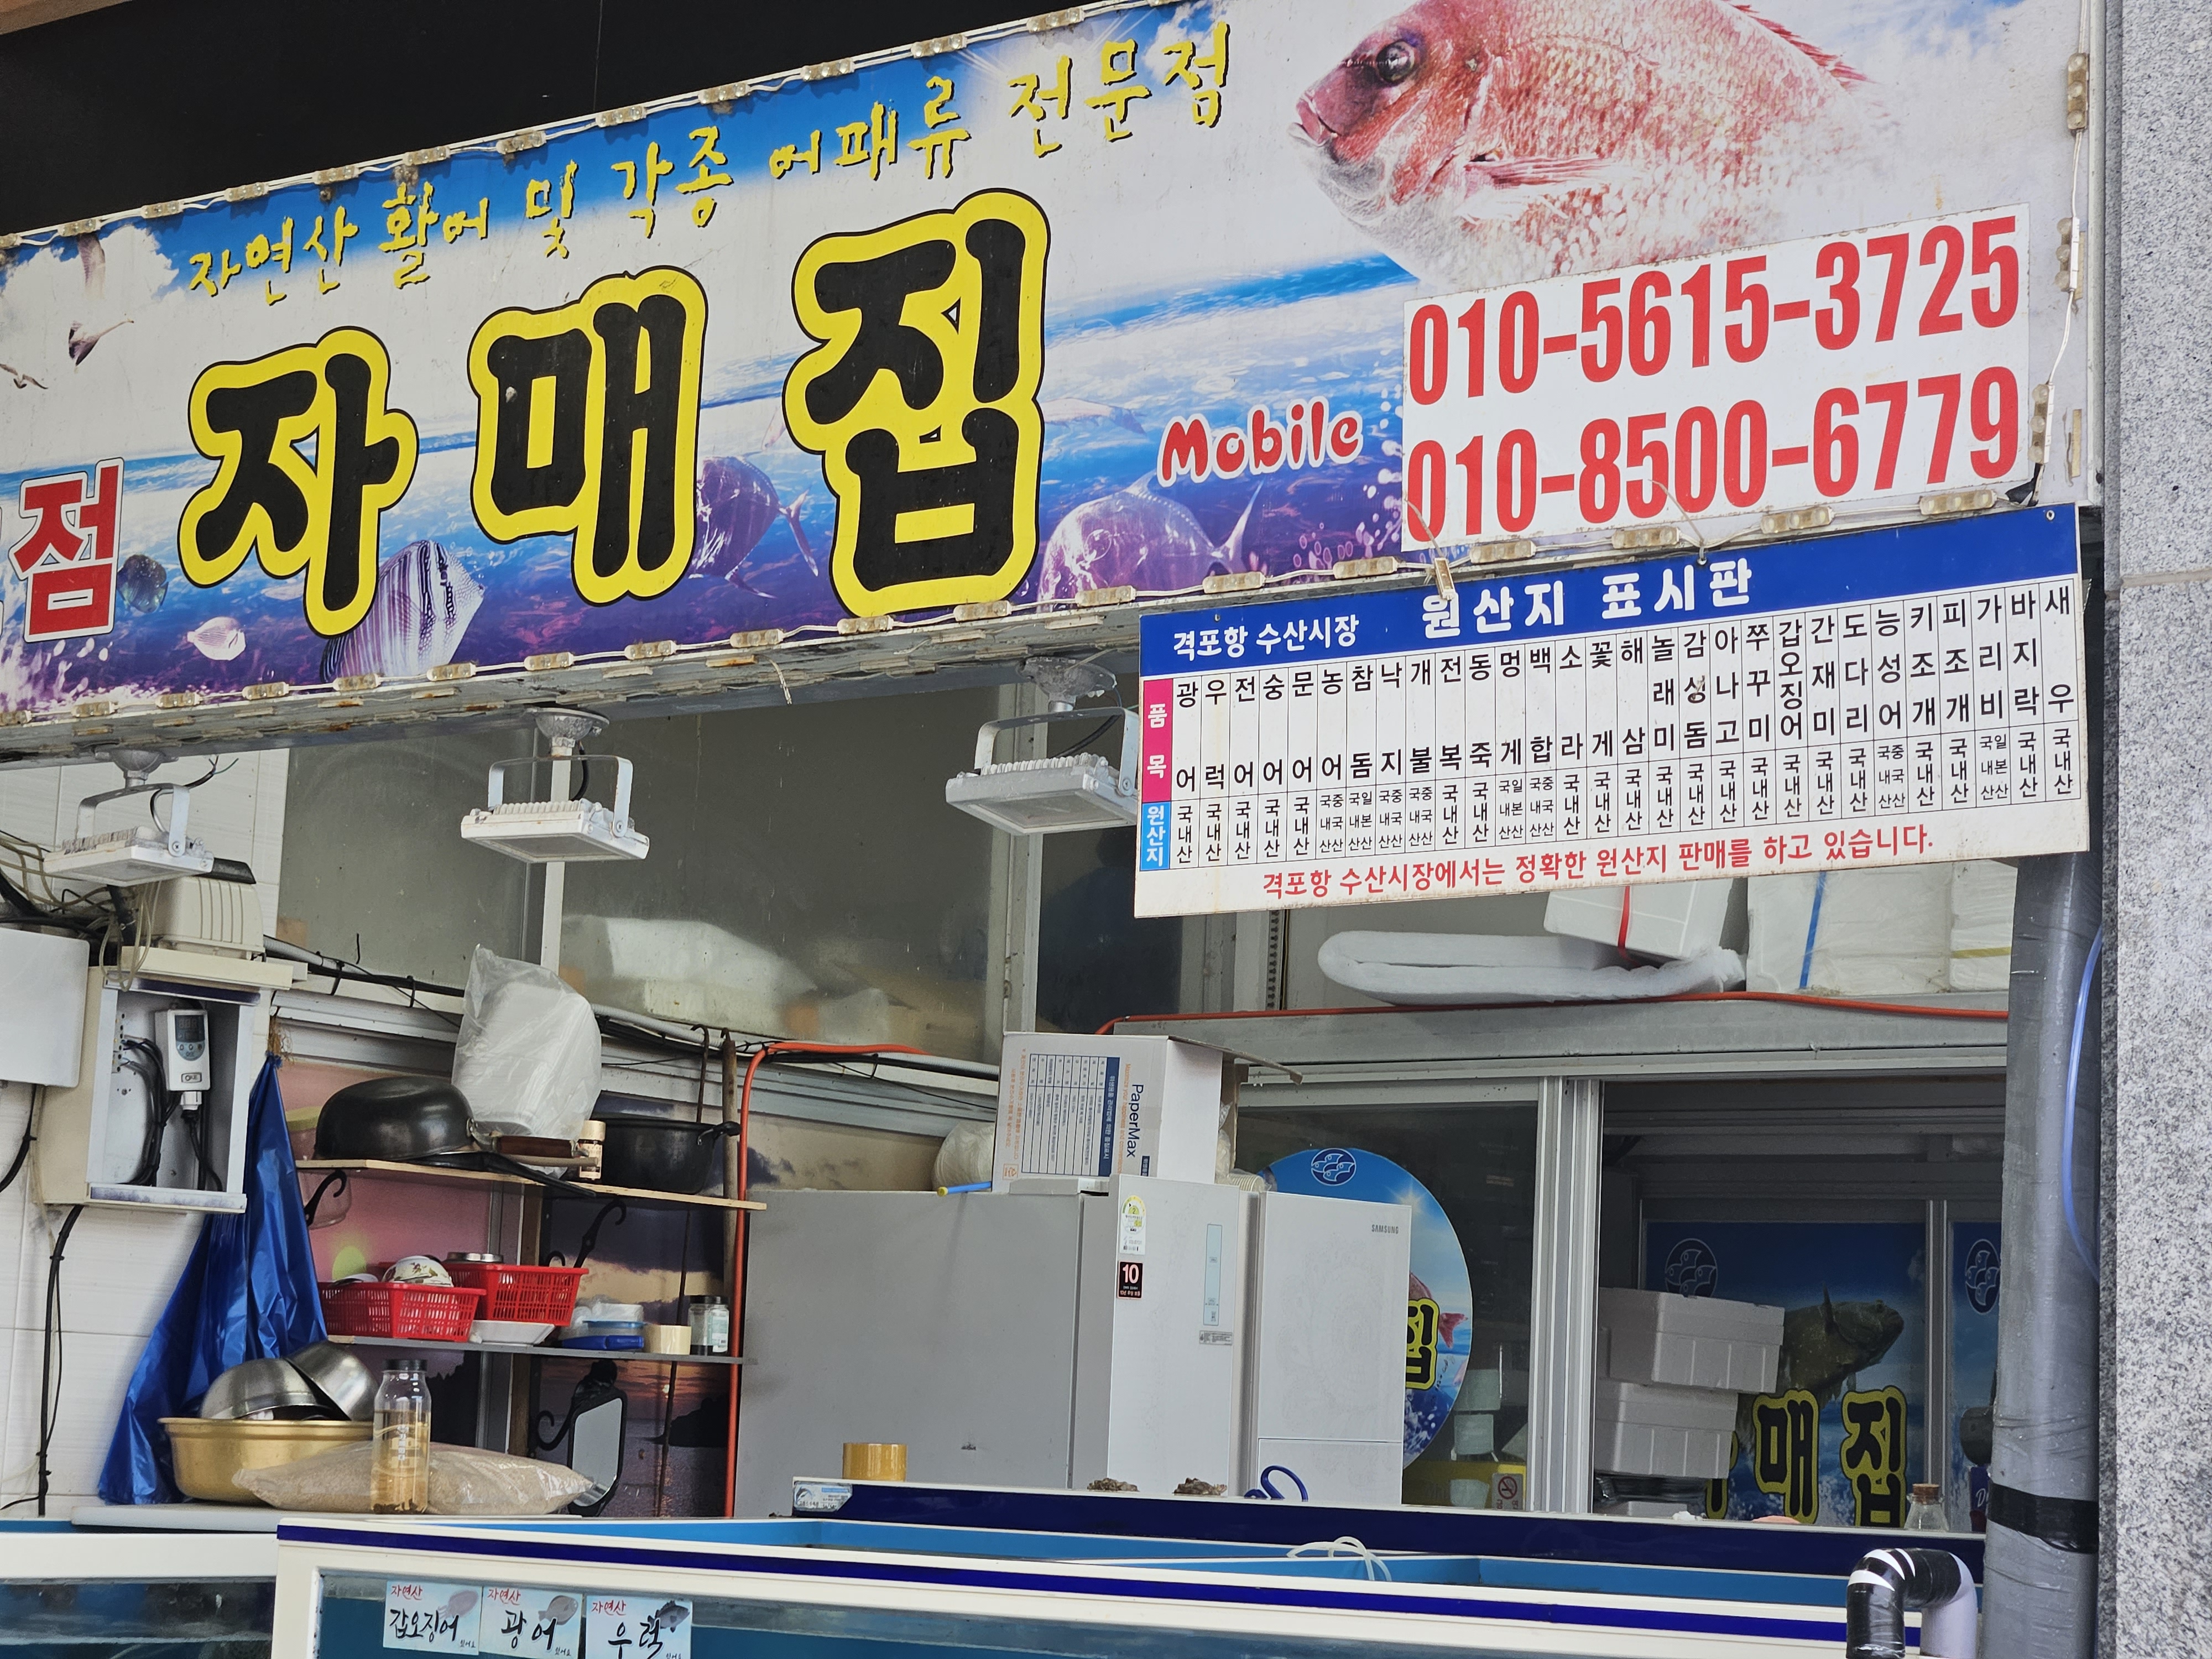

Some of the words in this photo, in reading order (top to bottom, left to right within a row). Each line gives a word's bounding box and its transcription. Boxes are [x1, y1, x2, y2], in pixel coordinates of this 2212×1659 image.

[189, 206, 358, 305] 자연산
[378, 182, 489, 288] 활어
[526, 161, 577, 258] 및
[612, 124, 733, 238] 각종
[769, 76, 970, 179] 어패류
[1008, 21, 1229, 155] 전문점
[1409, 215, 2020, 408] 010-5615-3725
[179, 191, 1049, 638] 자매집
[1159, 399, 1361, 482] Mobile
[1407, 366, 2020, 543] 010-8500-6779
[1422, 580, 1564, 640] 원산지
[1601, 557, 1752, 620] 표시판
[1173, 625, 1248, 662] 격포항
[1256, 614, 1360, 655] 수산시장
[1875, 609, 1901, 729] 능성어
[1910, 602, 1935, 726] 키조개
[1943, 598, 1969, 722] 피조개
[1977, 594, 2002, 719] 가리비
[2011, 590, 2039, 716] 바지락
[2044, 585, 2074, 713] 새우
[1530, 646, 1552, 763] 백합
[1559, 645, 1583, 760] 소라
[1589, 641, 1613, 757] 꽃게
[1620, 637, 1645, 755] 해삼
[1651, 635, 1674, 751] 놀래미
[1714, 626, 1739, 743] 아나고
[1746, 623, 1770, 742] 쭈꾸미
[1778, 619, 1803, 740] 갑오징어
[1811, 615, 1834, 735] 간재미
[1843, 613, 1868, 732] 도다리
[1176, 681, 1198, 792] 광어
[1205, 679, 1227, 789] 우럭
[1234, 676, 1255, 787] 전어
[1262, 674, 1285, 785] 숭어
[1292, 671, 1314, 782] 문어
[1321, 669, 1343, 780] 농어
[1350, 665, 1373, 779] 참돔
[1380, 661, 1402, 775] 낙지
[1409, 659, 1432, 774] 개불
[1439, 655, 1462, 770] 전복
[1469, 654, 1491, 768] 동죽
[1500, 650, 1521, 765] 멍게
[1719, 760, 1736, 823] 국내산
[1751, 757, 1769, 820] 국내산
[1783, 754, 1802, 817] 국내산
[1815, 751, 1834, 815] 국내산
[1848, 748, 1867, 812] 국내산
[1877, 745, 1891, 808] 국내산
[1891, 744, 1905, 807] 중국산
[1915, 741, 1934, 806] 국내산
[1949, 738, 1968, 803] 국내산
[1979, 735, 1994, 800] 국내산
[1994, 733, 2008, 799] 일본산
[2017, 731, 2038, 797] 국내산
[2052, 728, 2073, 795] 국내산
[1293, 796, 1310, 855] 국내산
[1319, 795, 1331, 853] 국내산
[1331, 794, 1344, 852] 중국산
[1348, 792, 1360, 851] 국내산
[1360, 791, 1372, 850] 일본산
[1378, 790, 1390, 848] 국내산
[1390, 789, 1402, 848] 중국산
[1408, 787, 1420, 846] 국내산
[1421, 786, 1432, 846] 중국산
[1442, 784, 1458, 844] 국내산
[1472, 781, 1489, 842] 국내산
[1499, 780, 1511, 839] 국내산
[1511, 778, 1523, 838] 일본산
[1529, 777, 1541, 837] 국내산
[1541, 776, 1554, 836] 중국산
[1563, 774, 1580, 835] 국내산
[1594, 771, 1611, 833] 국내산
[1625, 768, 1642, 830] 국내산
[1656, 765, 1673, 828] 국내산
[1687, 763, 1705, 826] 국내산
[1146, 805, 1166, 867] 원산지
[1176, 805, 1193, 863] 국내산
[1206, 803, 1222, 862] 국내산
[1234, 801, 1251, 859] 국내산
[1264, 799, 1280, 857] 국내산
[1263, 869, 1332, 900] 격포항
[1339, 858, 1505, 896] 수산시장에서는
[1515, 851, 1587, 884] 정확한
[1596, 844, 1667, 878] 원산지
[1678, 838, 1752, 872] 판매를
[1763, 834, 1813, 865] 하고
[1823, 823, 1933, 860] 있습니다.
[1126, 1083, 1144, 1158] PaperMax
[1371, 1224, 1399, 1235] SAMSUNG
[1122, 1264, 1139, 1284] 10
[390, 1584, 424, 1601] 자연산
[487, 1588, 521, 1605] 자연산
[591, 1600, 627, 1616] 자연산
[389, 1608, 460, 1643] 갑오징어
[460, 1639, 476, 1649] 있어요
[500, 1609, 557, 1650] 광어
[555, 1647, 572, 1657] 있어요
[607, 1621, 664, 1659] 우럭
